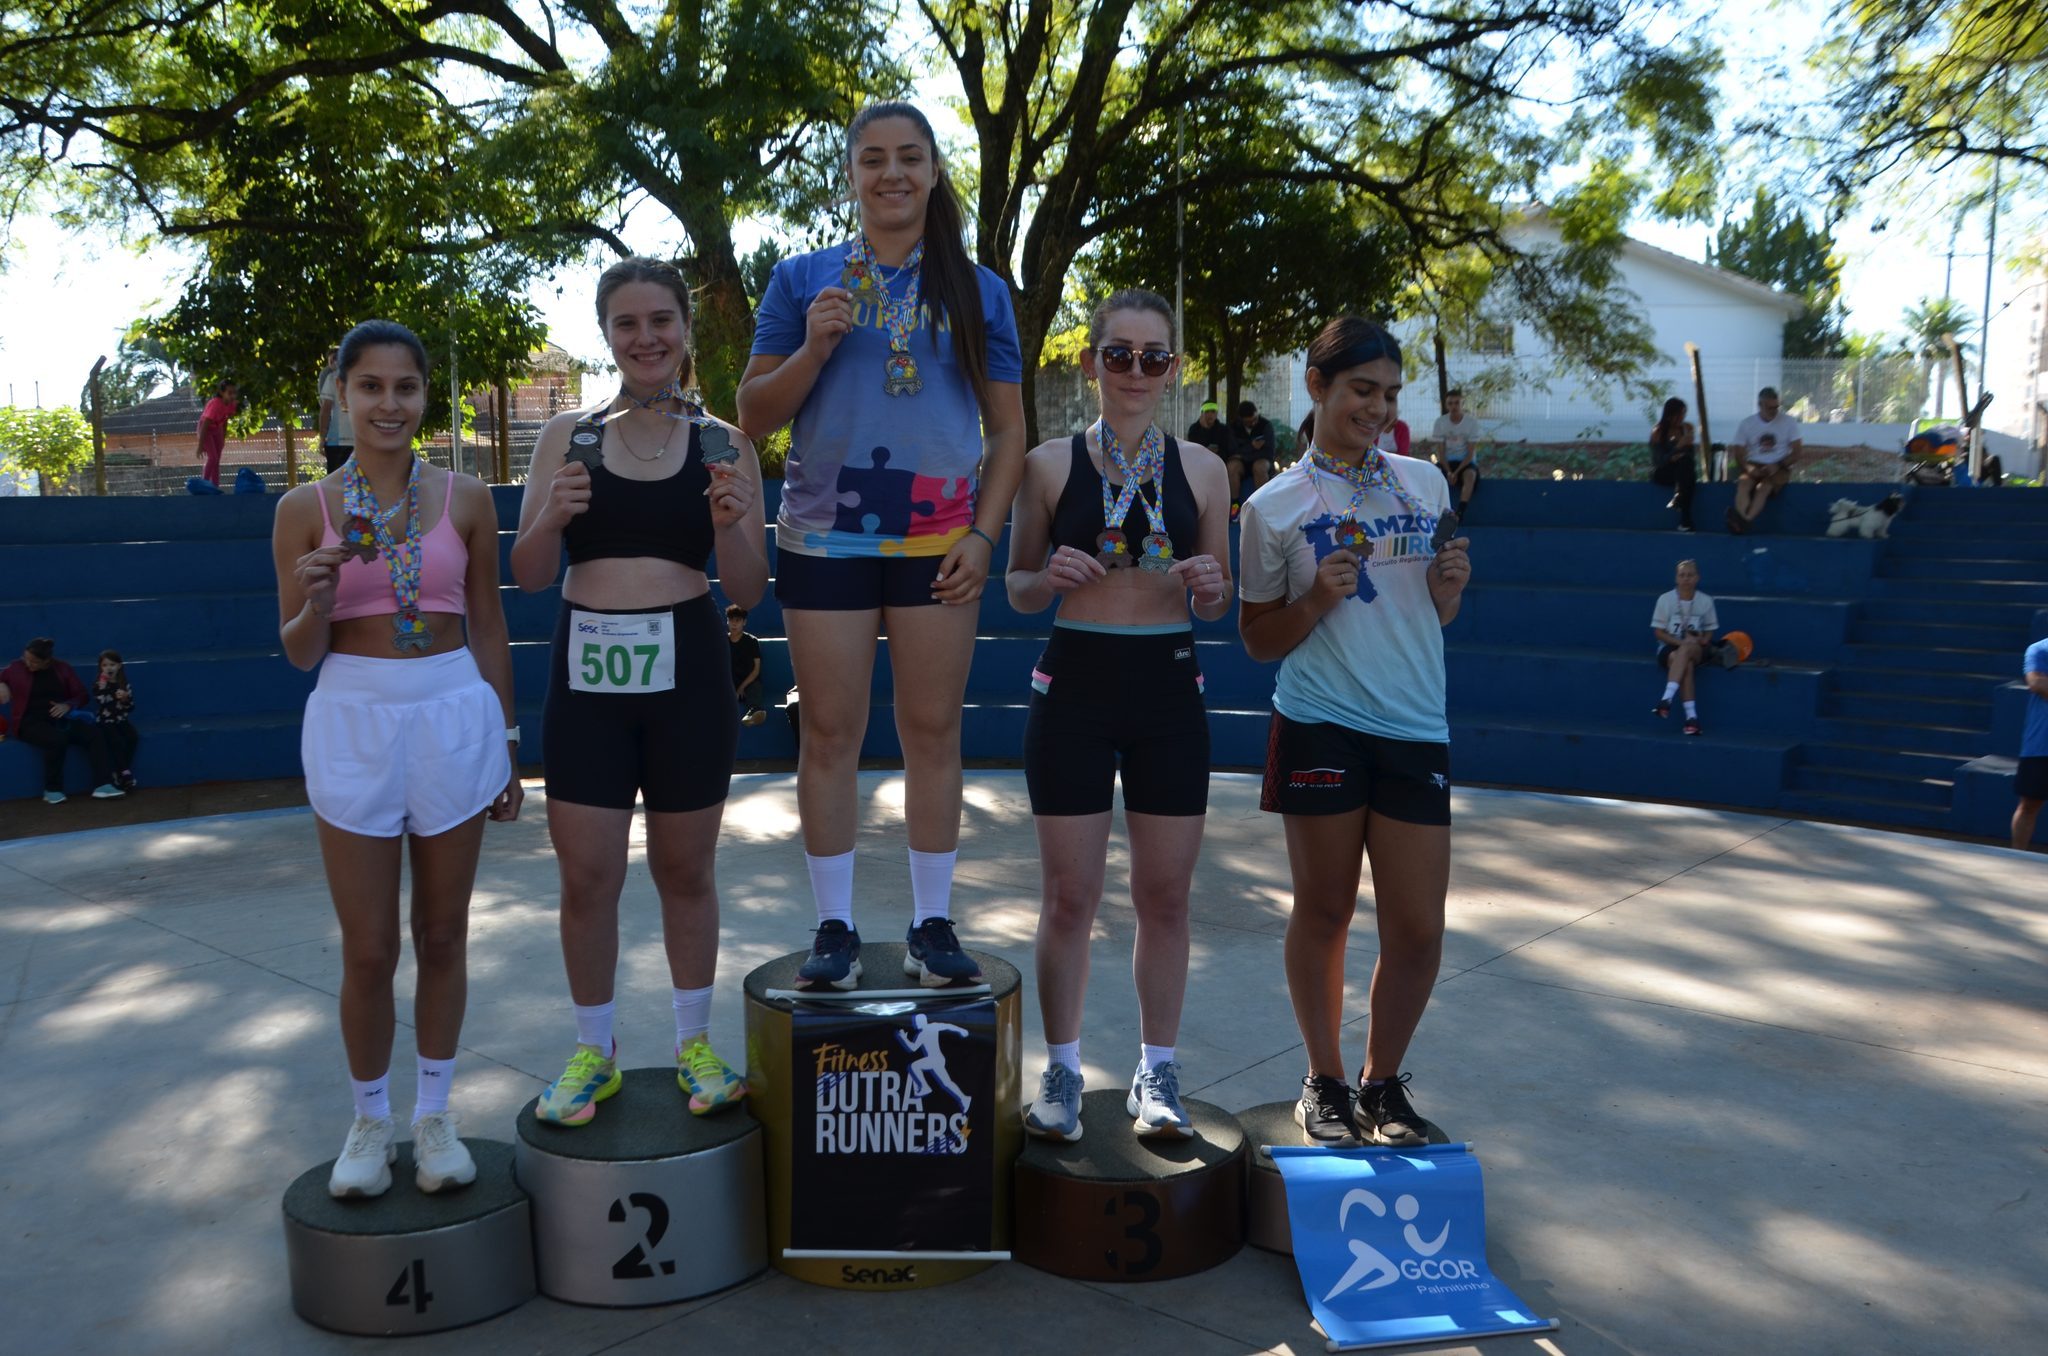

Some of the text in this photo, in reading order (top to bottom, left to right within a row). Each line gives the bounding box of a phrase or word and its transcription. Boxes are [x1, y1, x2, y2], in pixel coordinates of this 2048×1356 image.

[1372, 557, 1398, 568] Circuito
[581, 642, 660, 687] 507
[812, 1042, 889, 1077] Fitness
[816, 1070, 924, 1112] DUTRA
[816, 1112, 969, 1154] RUNNERS
[607, 1192, 676, 1280] 2
[1104, 1190, 1163, 1276] 3
[385, 1258, 434, 1314] 4
[842, 1264, 915, 1284] Senac
[1400, 1259, 1480, 1280] GCOR
[1416, 1282, 1490, 1295] Palmitinho
